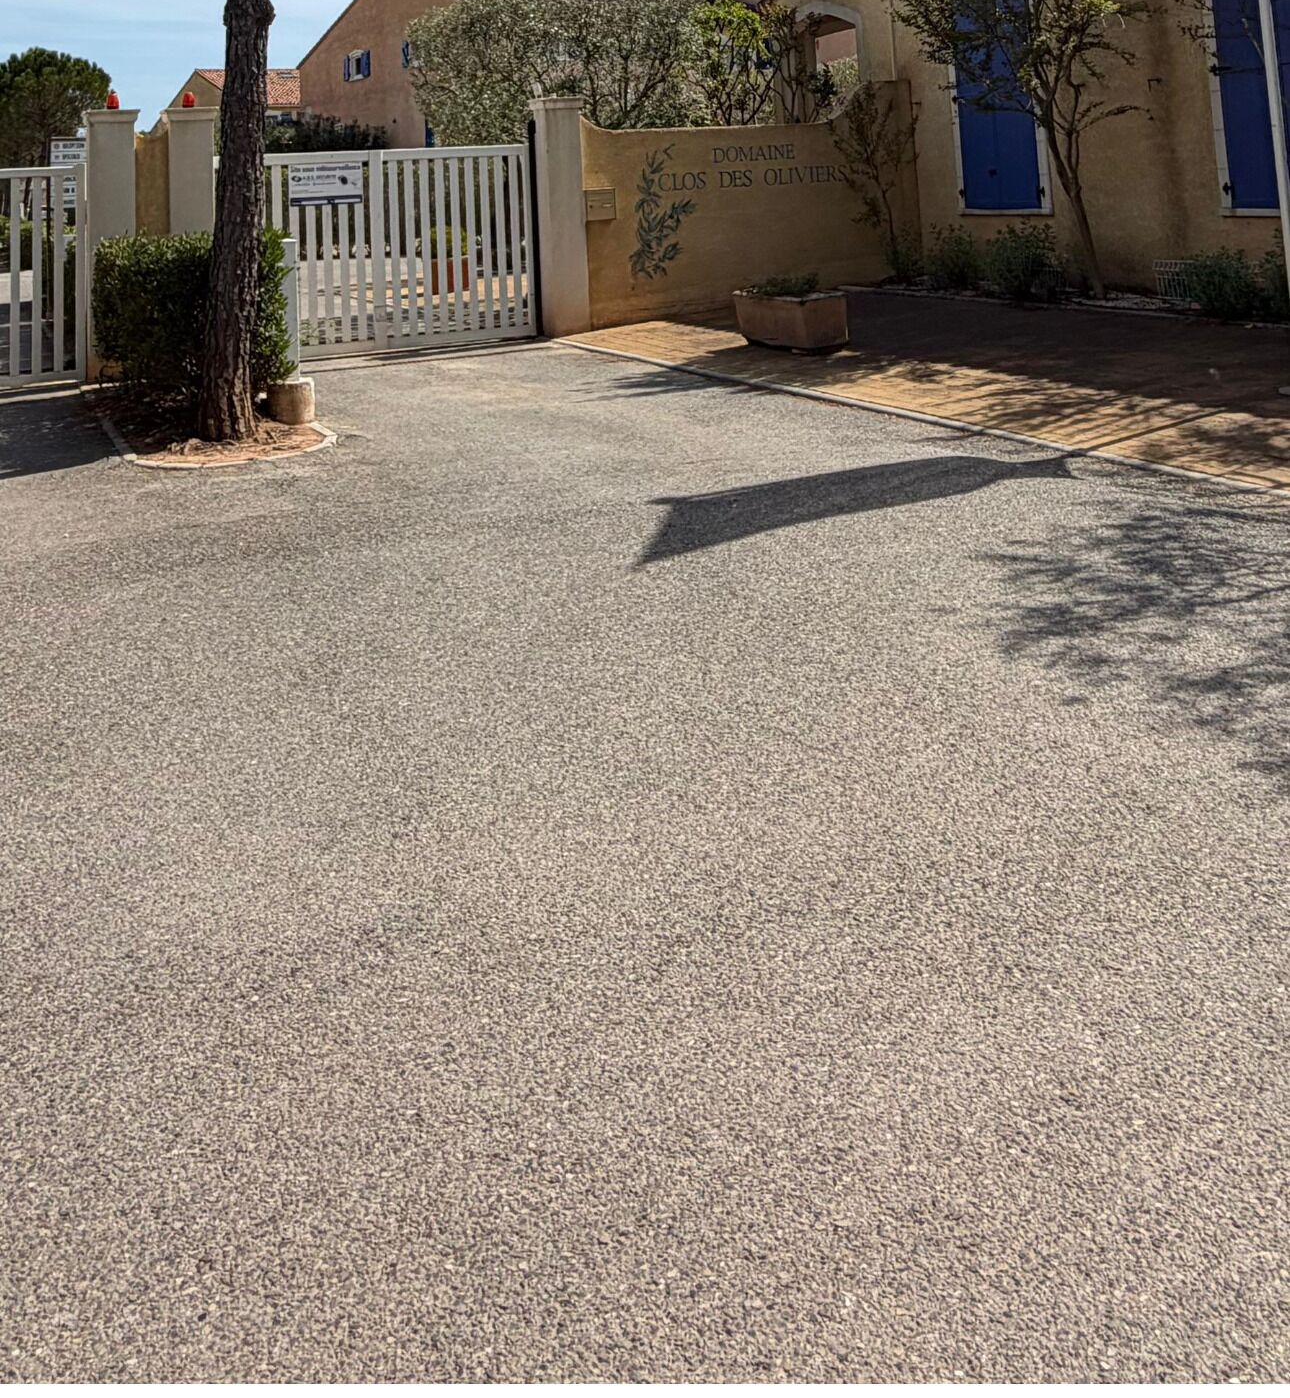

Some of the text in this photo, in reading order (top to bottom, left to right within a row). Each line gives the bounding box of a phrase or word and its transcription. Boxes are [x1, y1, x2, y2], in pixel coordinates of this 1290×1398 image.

[712, 143, 796, 164] DOMAINE
[657, 164, 849, 192] CLOS DES OLIVIERS
